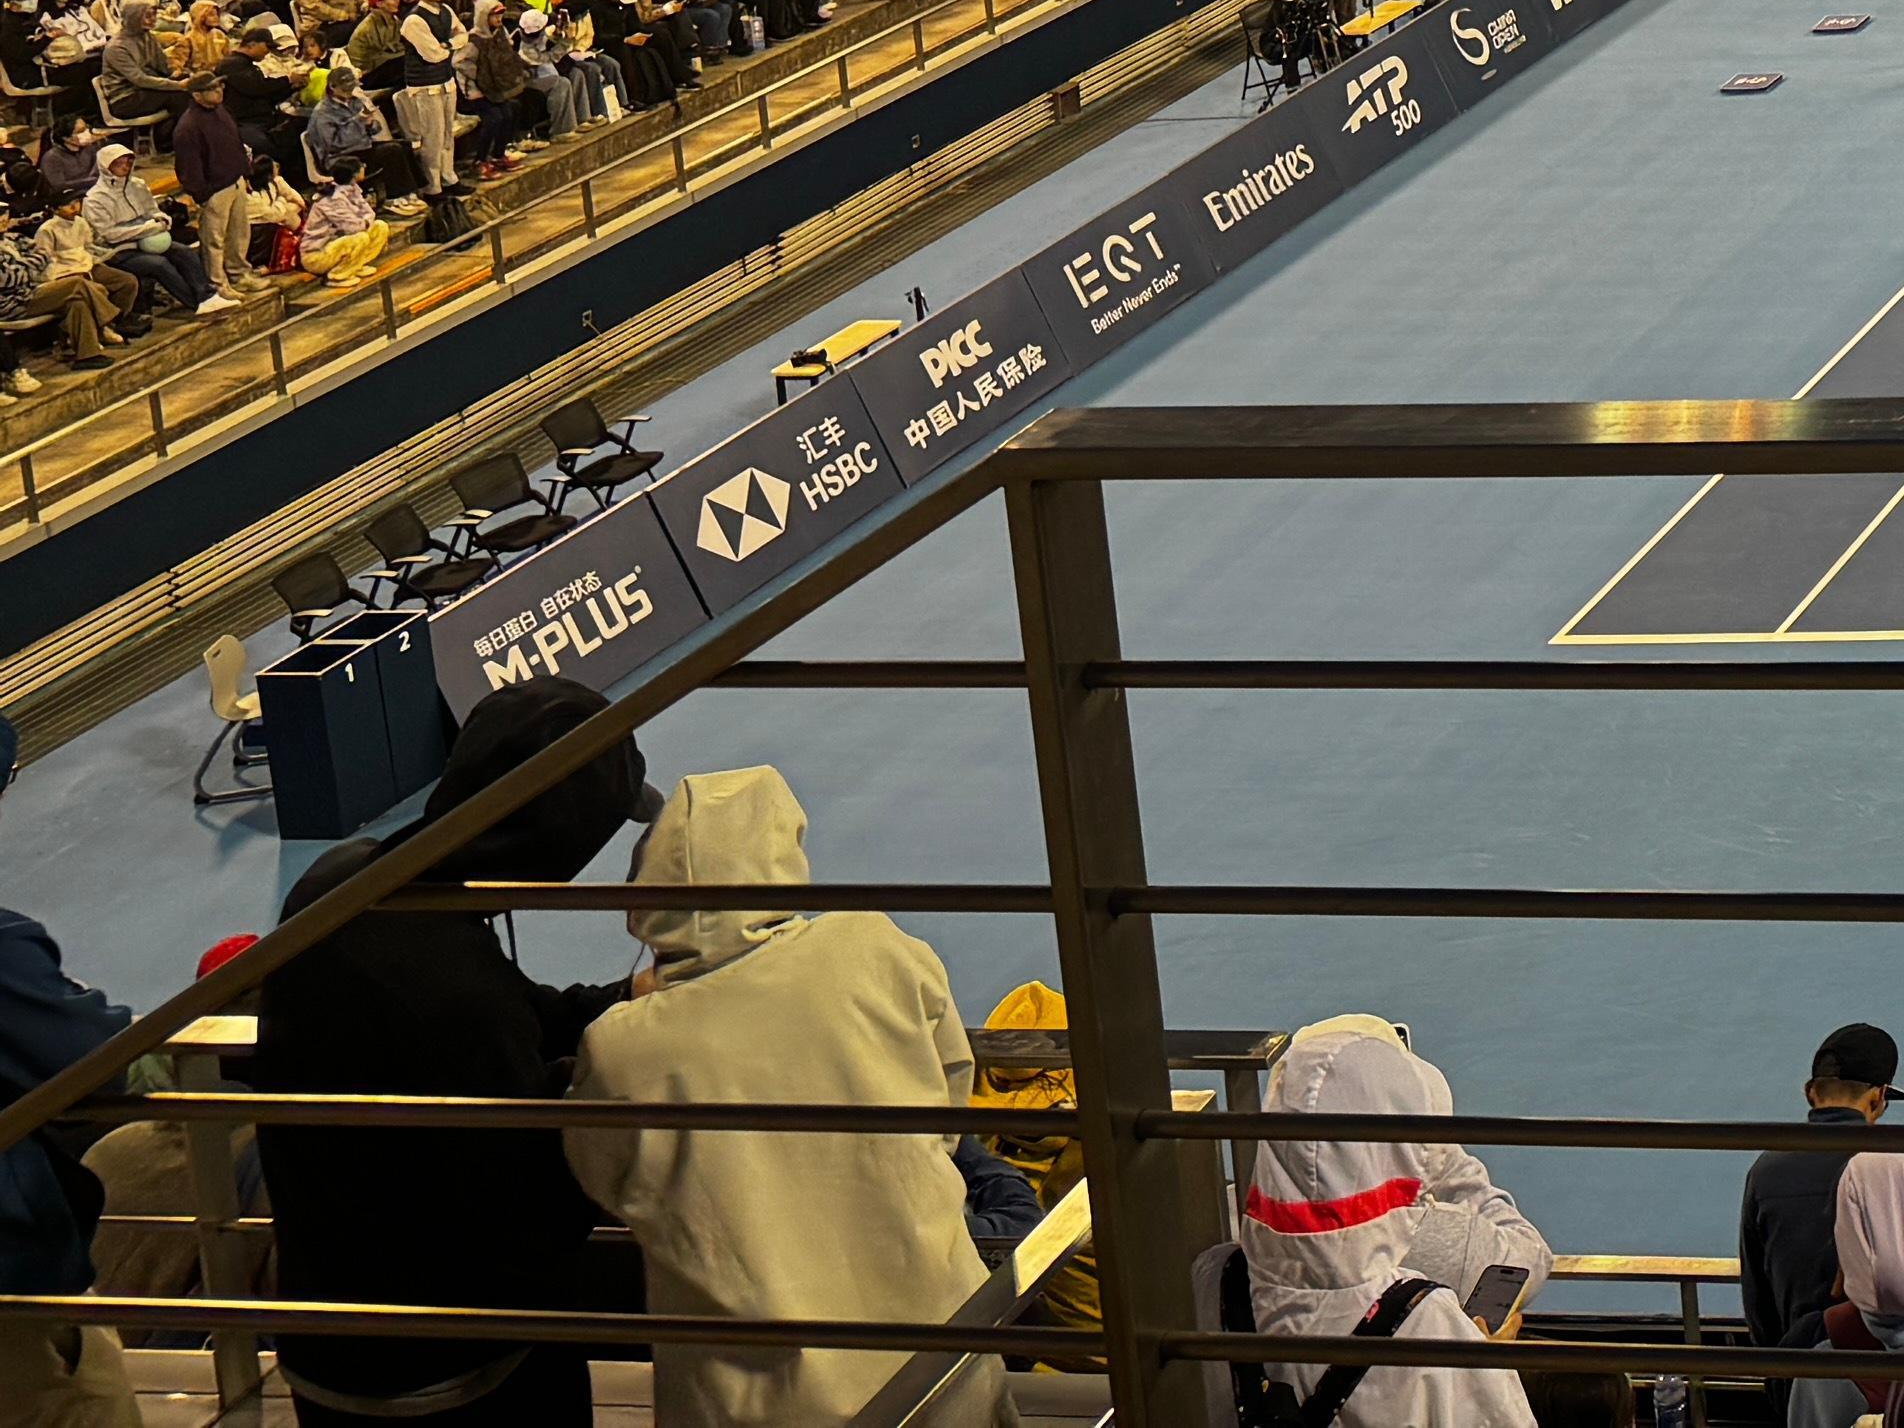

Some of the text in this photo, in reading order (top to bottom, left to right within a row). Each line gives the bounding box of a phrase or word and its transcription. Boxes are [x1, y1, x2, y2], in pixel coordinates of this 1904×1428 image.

[1341, 55, 1410, 135] ATP
[1391, 99, 1423, 137] 500
[1203, 143, 1314, 232] Emirates
[1062, 211, 1165, 309] EQT
[1091, 300, 1123, 335] Better
[1121, 281, 1152, 316] Never
[919, 319, 993, 388] PICC
[903, 342, 1048, 451] 中国人民保险
[795, 415, 847, 464] 汇丰
[799, 440, 880, 512] HSBC
[398, 630, 411, 653] 2
[473, 570, 602, 658] 每日蛋白 自在状态
[344, 663, 355, 682] 1
